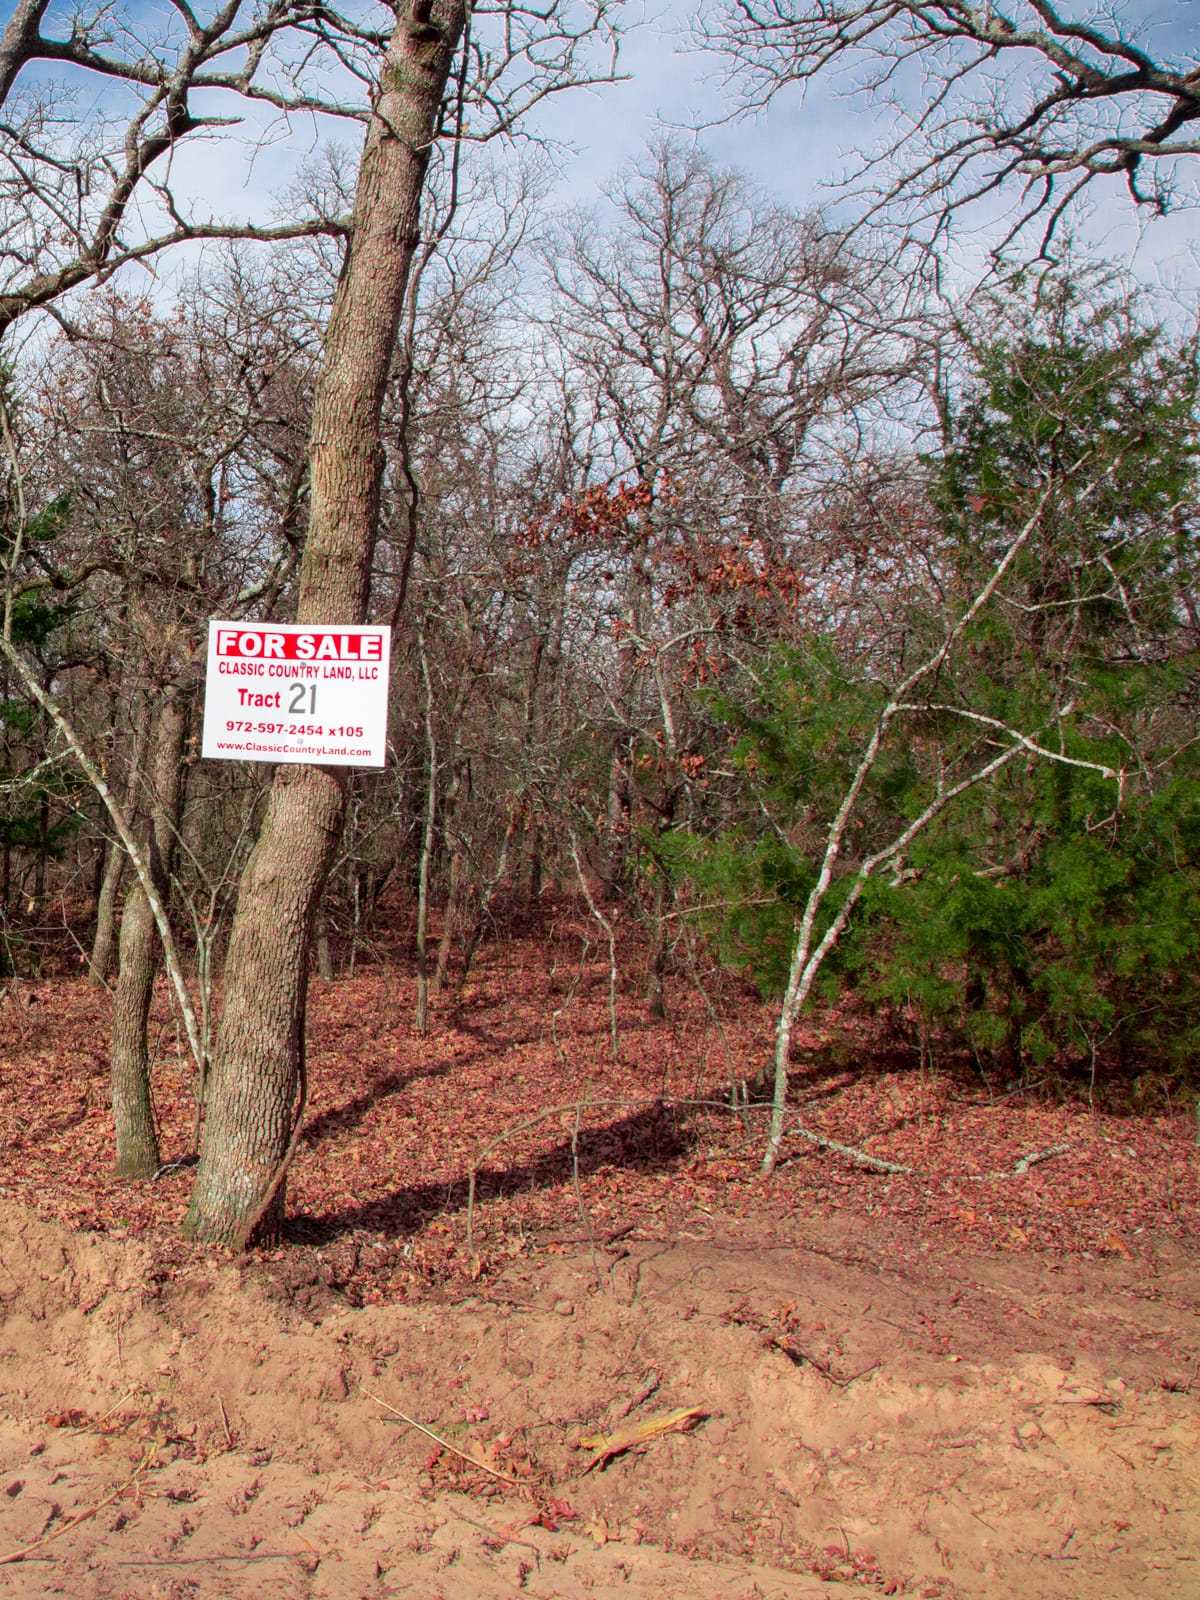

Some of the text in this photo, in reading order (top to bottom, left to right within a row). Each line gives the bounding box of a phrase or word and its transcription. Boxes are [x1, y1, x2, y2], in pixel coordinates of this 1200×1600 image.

[219, 631, 380, 660] FOR SALE
[219, 662, 378, 681] CLASSIC COUNTRY LAND, LLC
[238, 683, 316, 714] Tract 21
[226, 721, 363, 737] 972-597-2454 x105
[217, 742, 371, 757] www.ClassicCountryLand.com
